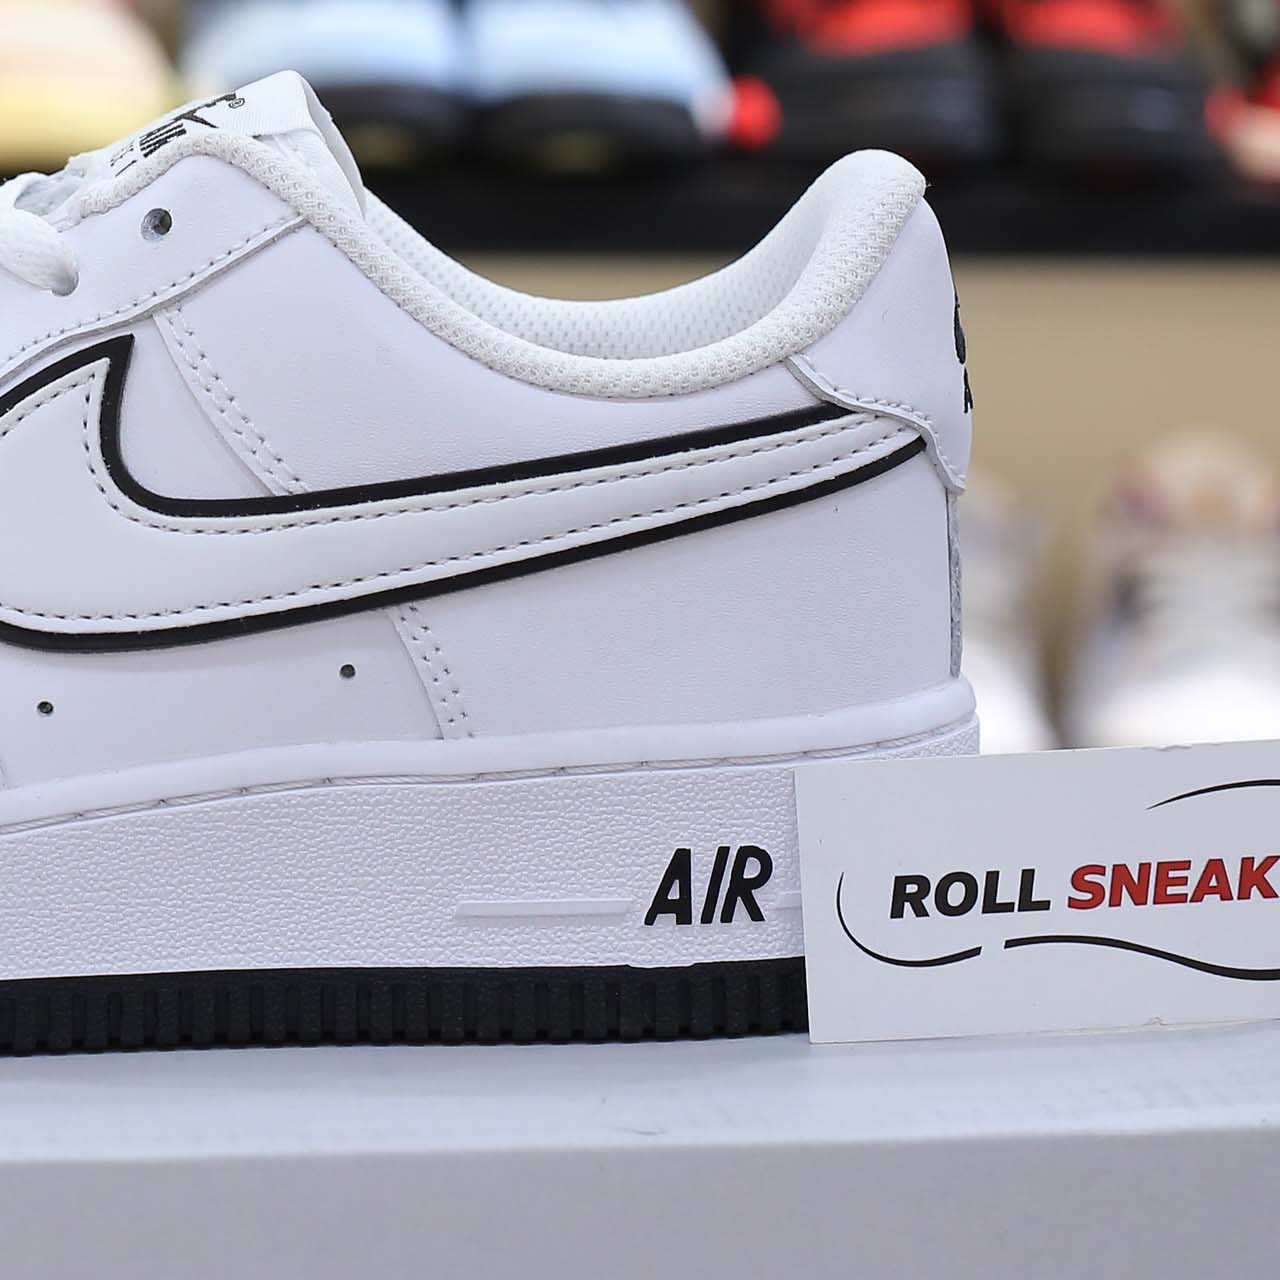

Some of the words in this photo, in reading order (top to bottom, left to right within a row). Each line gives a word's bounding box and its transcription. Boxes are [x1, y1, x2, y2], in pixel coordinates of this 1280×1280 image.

[644, 845, 774, 926] AIR
[889, 868, 1051, 920] ROLL
[1067, 855, 1280, 910] SNEAK
